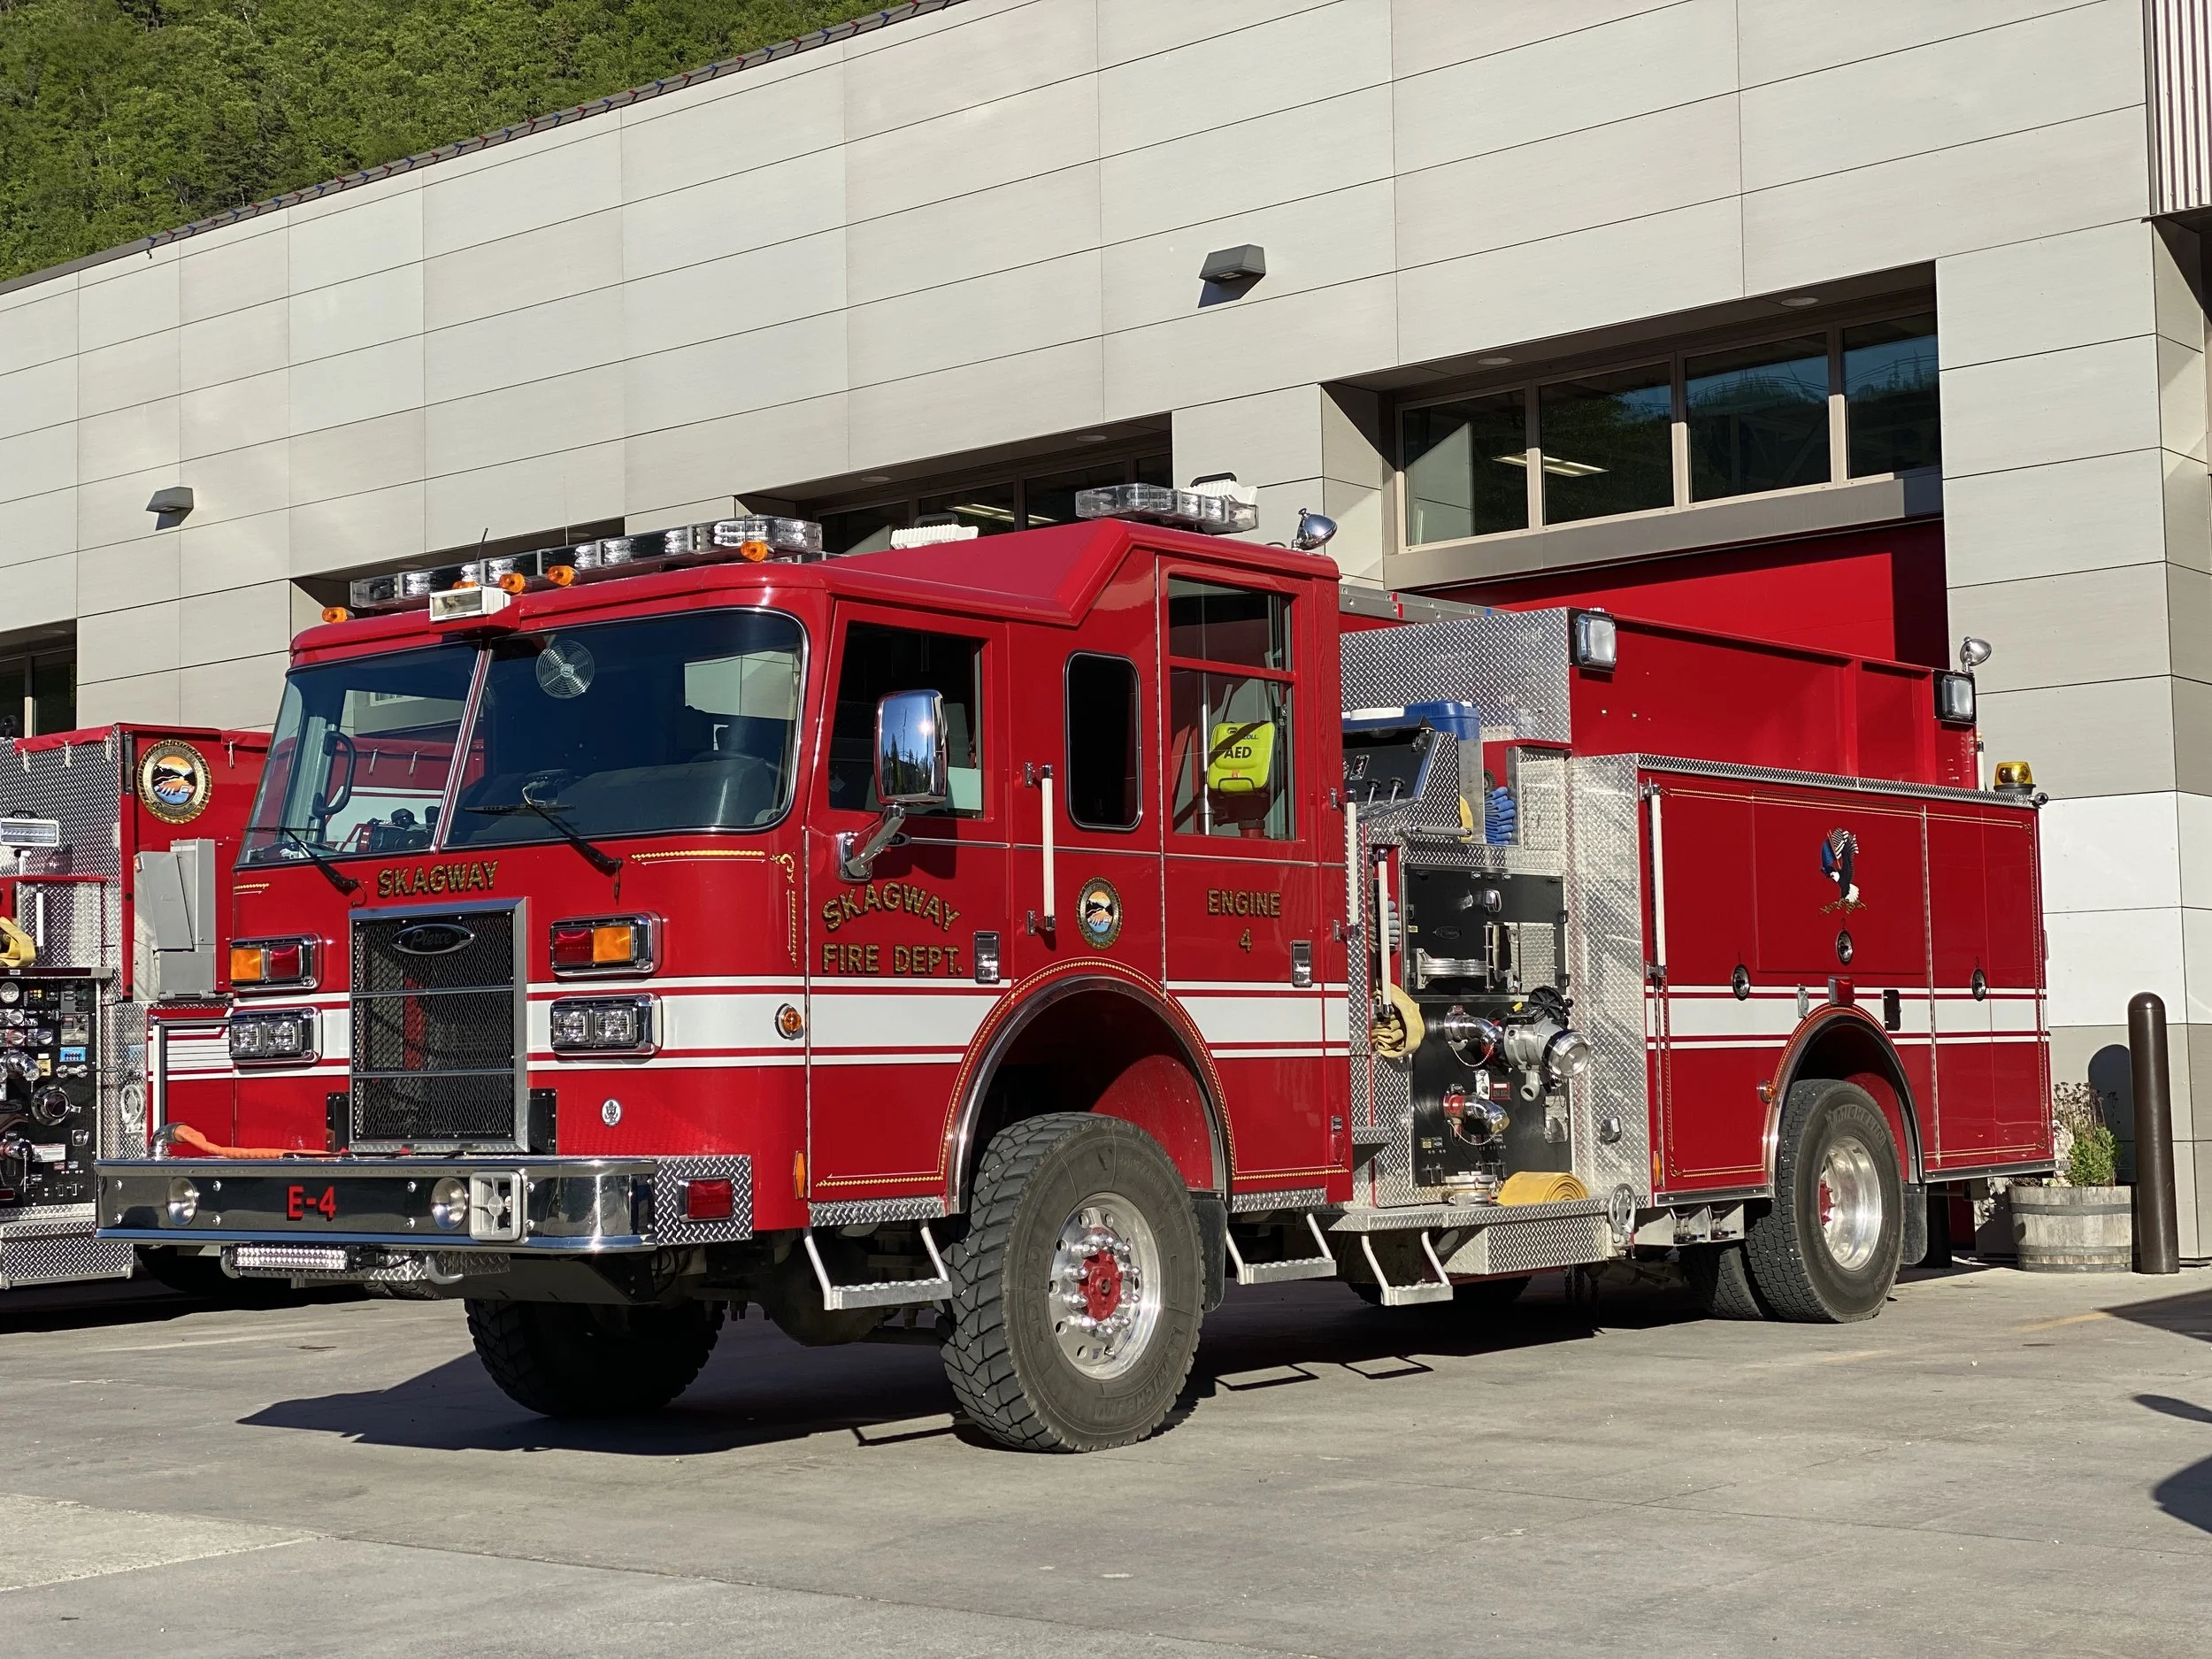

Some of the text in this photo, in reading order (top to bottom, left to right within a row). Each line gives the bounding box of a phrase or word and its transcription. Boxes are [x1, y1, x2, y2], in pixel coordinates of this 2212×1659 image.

[1224, 746, 1252, 758] AED
[378, 860, 499, 897] SKAGWAY
[822, 882, 961, 932] SKAGWAY
[1207, 888, 1281, 918] ENGINE
[410, 929, 451, 949] Pierce
[1240, 927, 1252, 953] 4
[823, 943, 963, 975] FIRE DEPT.
[1834, 1102, 1886, 1145] MICHELIN
[286, 1185, 337, 1222] E-4
